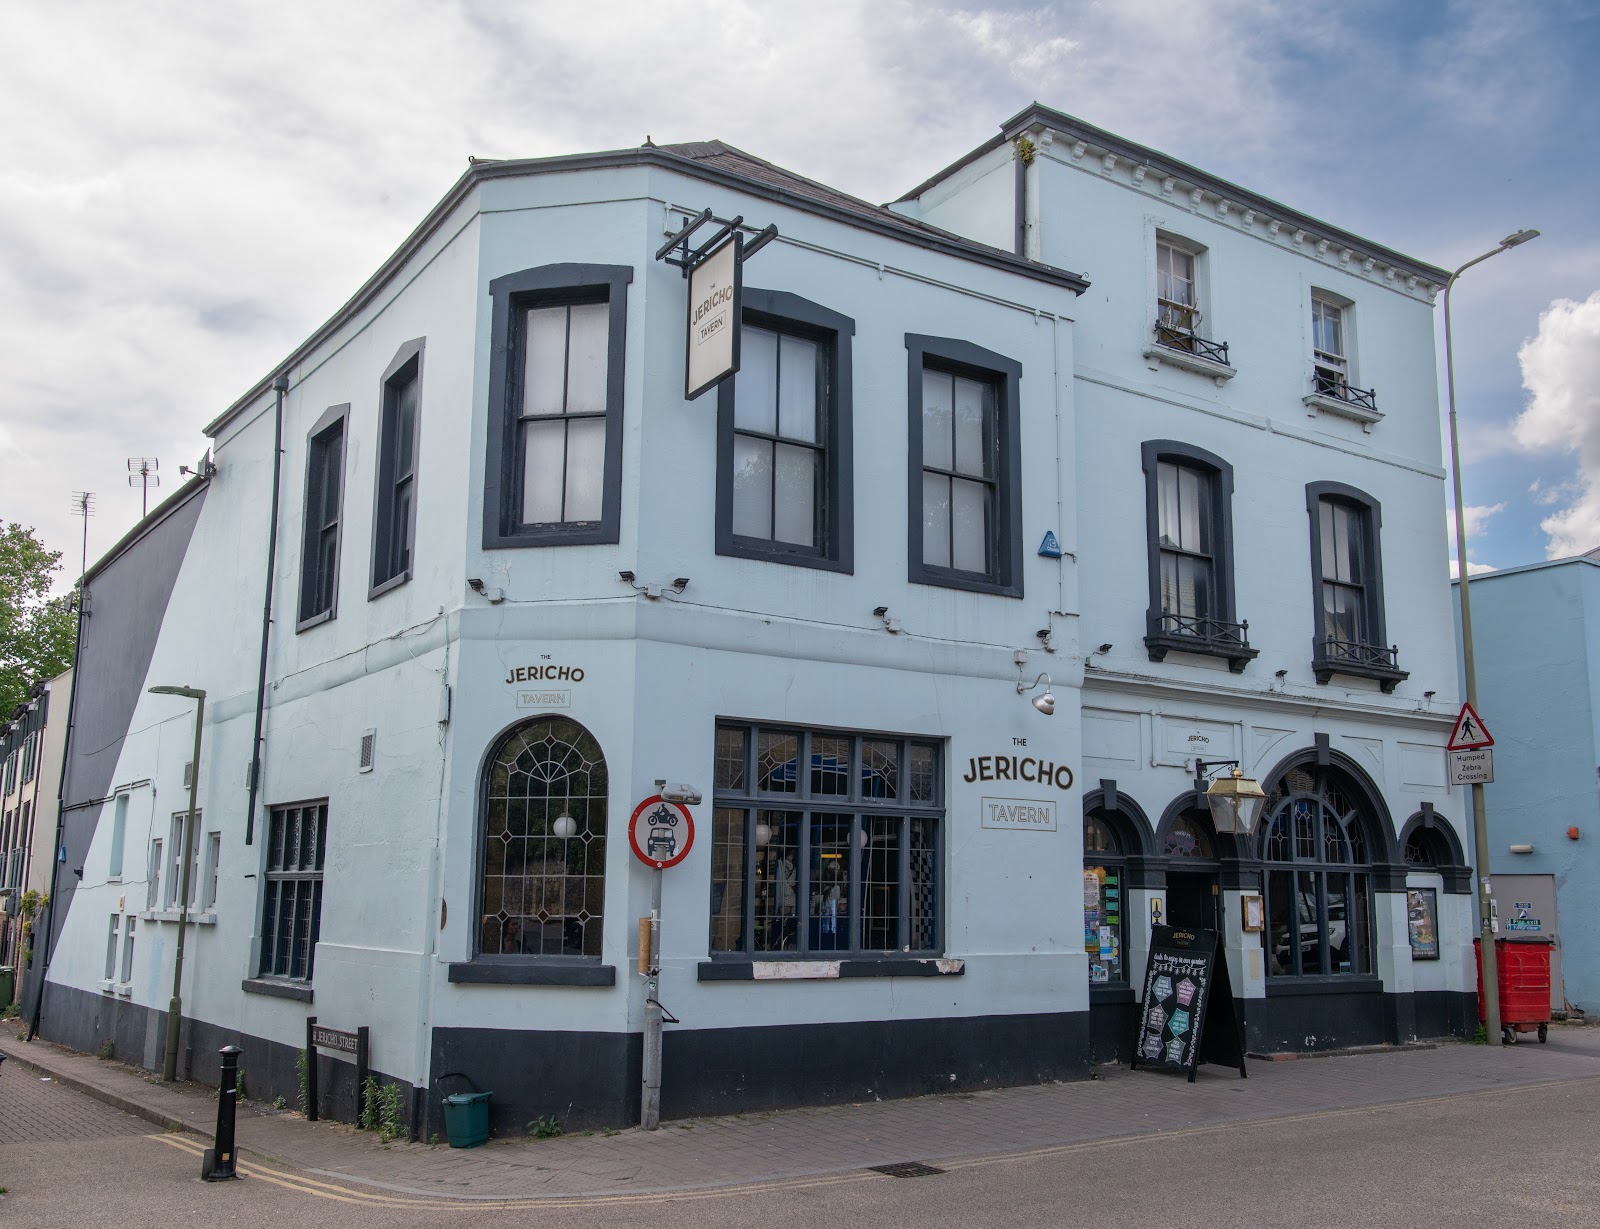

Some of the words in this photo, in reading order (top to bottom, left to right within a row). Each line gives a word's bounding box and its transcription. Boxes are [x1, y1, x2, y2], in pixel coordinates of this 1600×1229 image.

[693, 286, 733, 325] JERICHO
[701, 317, 723, 339] TAVERN
[505, 665, 585, 684] JERICHO
[521, 693, 566, 704] TAVERN
[1012, 737, 1027, 746] THE
[1187, 735, 1210, 744] JERICHO
[1456, 753, 1485, 762] Humped
[963, 756, 1073, 790] JERICHO
[1462, 764, 1481, 772] Zebra
[1457, 772, 1488, 781] Crossing
[988, 804, 1050, 824] TAVERN
[1172, 932, 1196, 941] JERICHO
[317, 1031, 338, 1046] JERICHO
[339, 1035, 358, 1051] STREET
